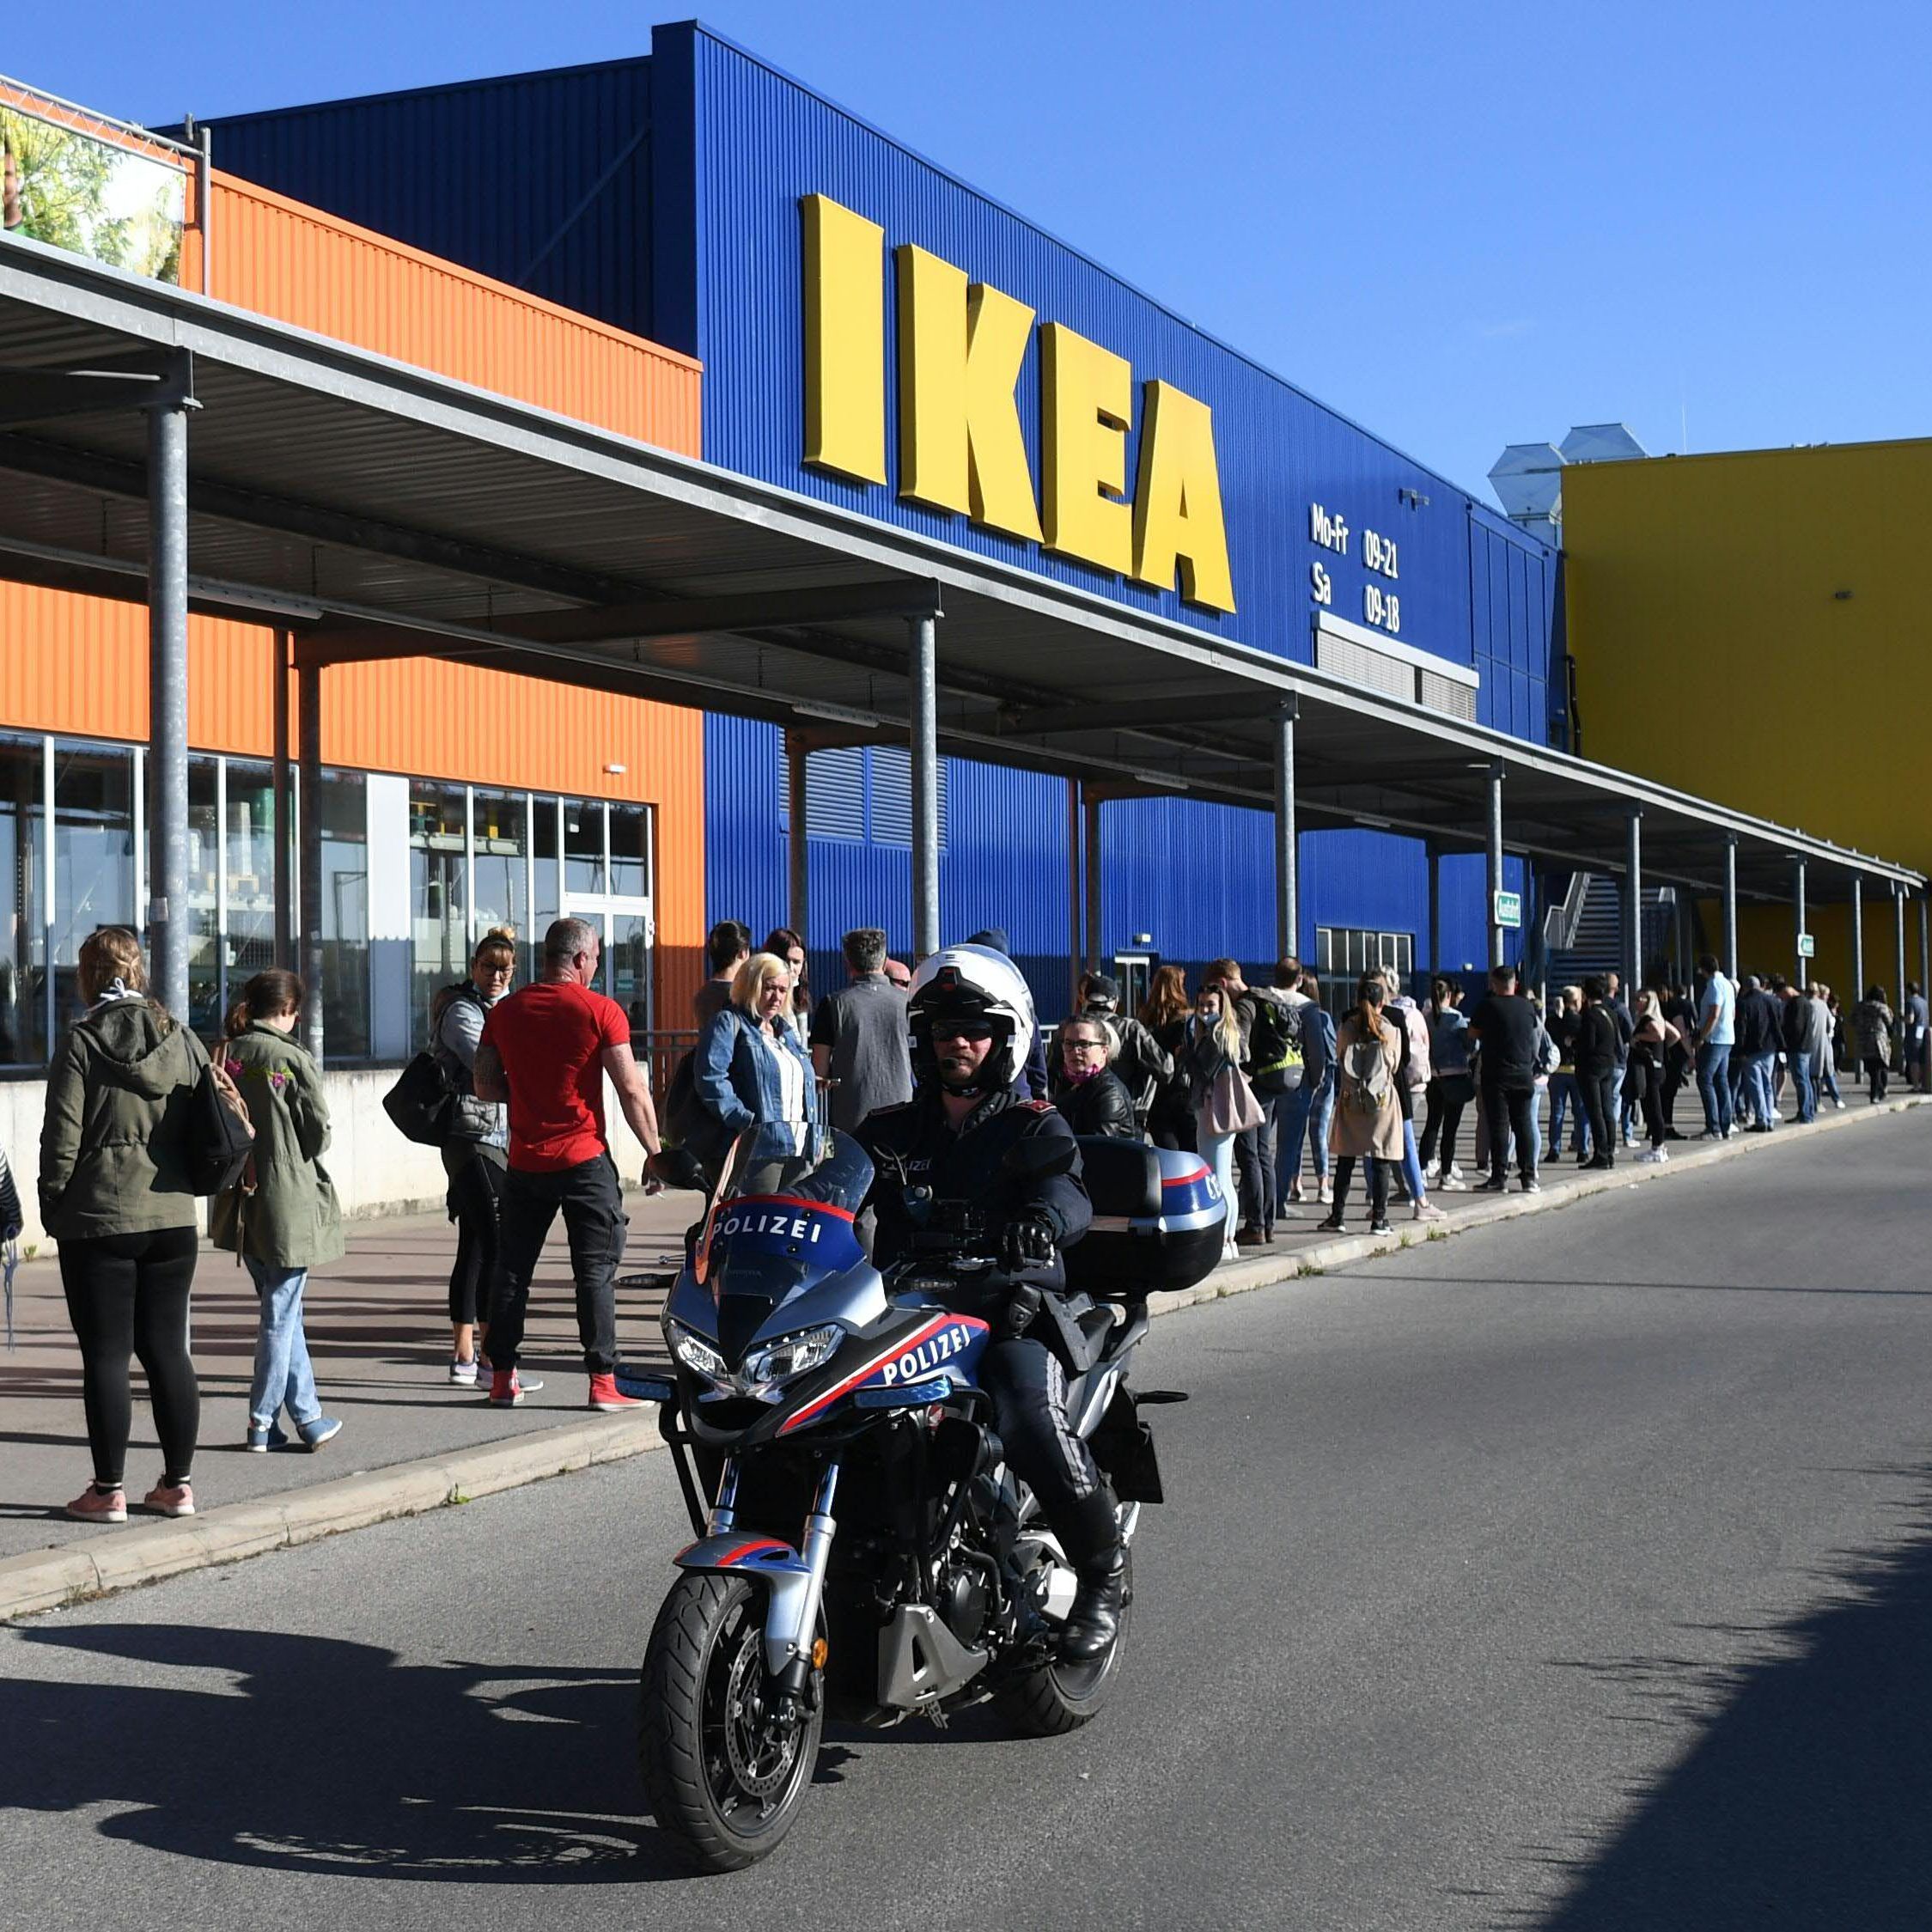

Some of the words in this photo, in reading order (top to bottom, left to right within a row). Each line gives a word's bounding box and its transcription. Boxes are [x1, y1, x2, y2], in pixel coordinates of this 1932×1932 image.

[803, 193, 1236, 613] IKEA
[1312, 503, 1349, 555] Mo-Fr
[1364, 529, 1399, 579] 09-21
[1313, 562, 1332, 605] Sa
[1365, 584, 1400, 633] 09-18
[712, 1215, 821, 1243] POLIZEI
[883, 1325, 971, 1386] POLIZEI
